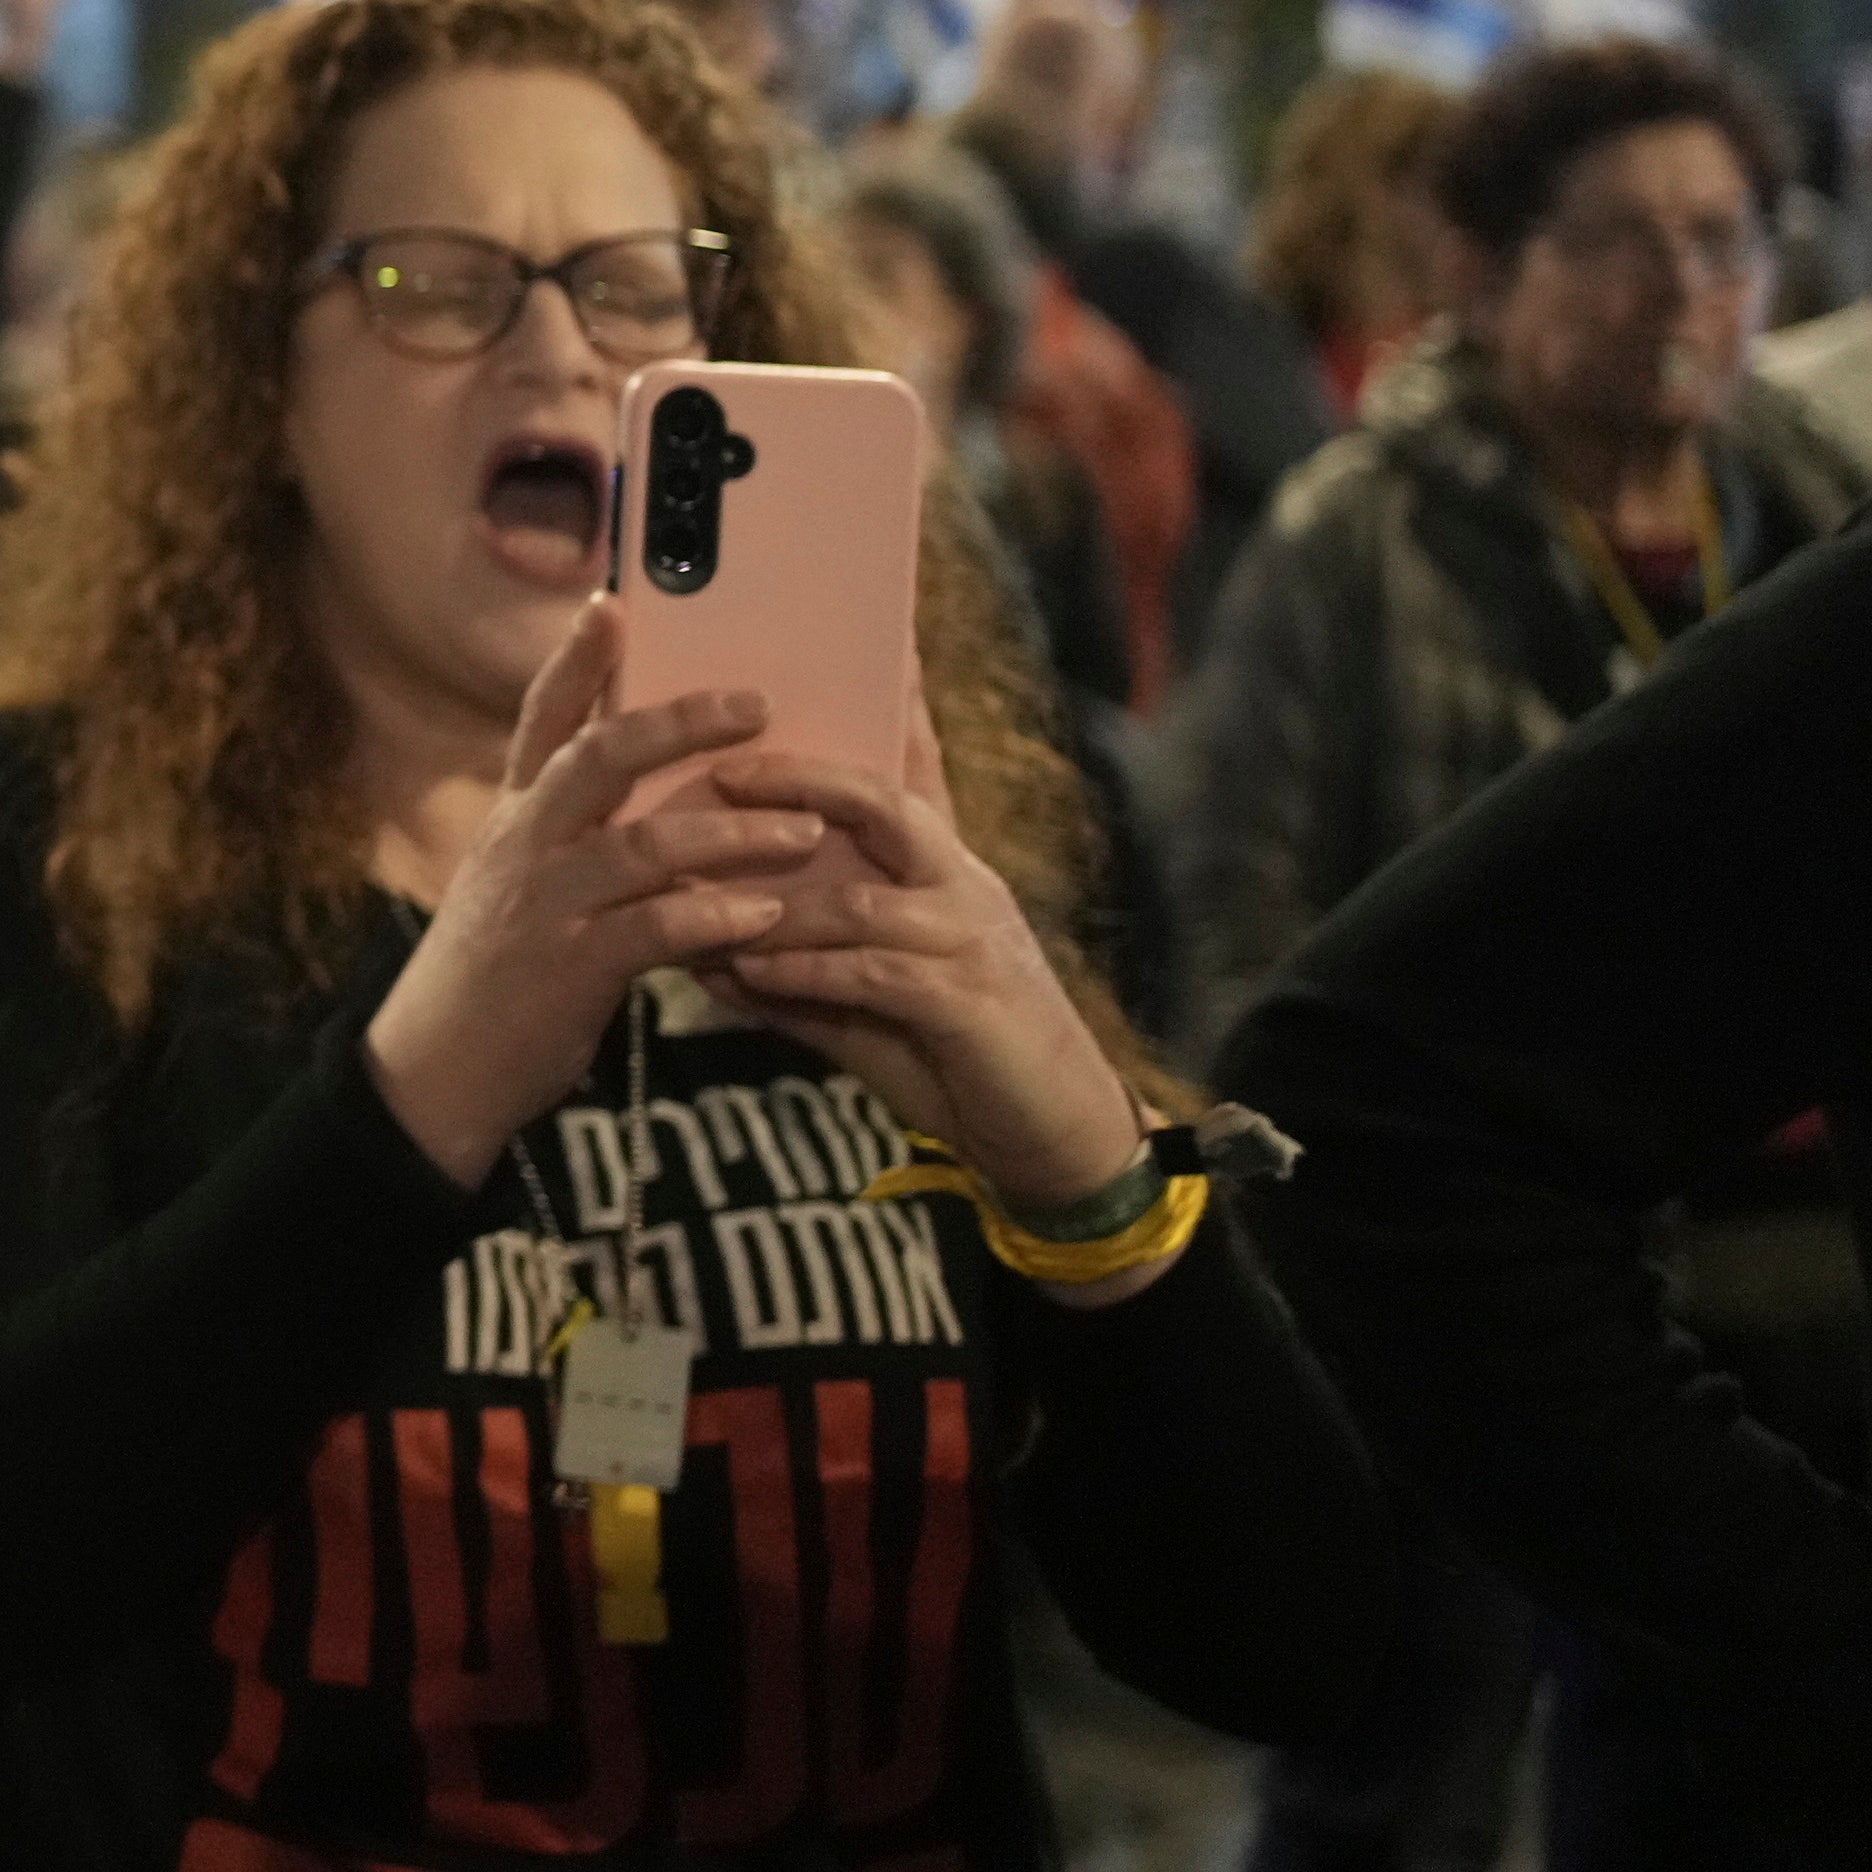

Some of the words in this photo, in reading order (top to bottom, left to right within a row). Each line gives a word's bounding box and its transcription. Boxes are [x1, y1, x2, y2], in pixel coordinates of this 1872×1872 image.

[556, 1075, 912, 1232] מחזירים
[711, 1199, 965, 1350] אותם
[211, 1378, 972, 1856] עכשיו
